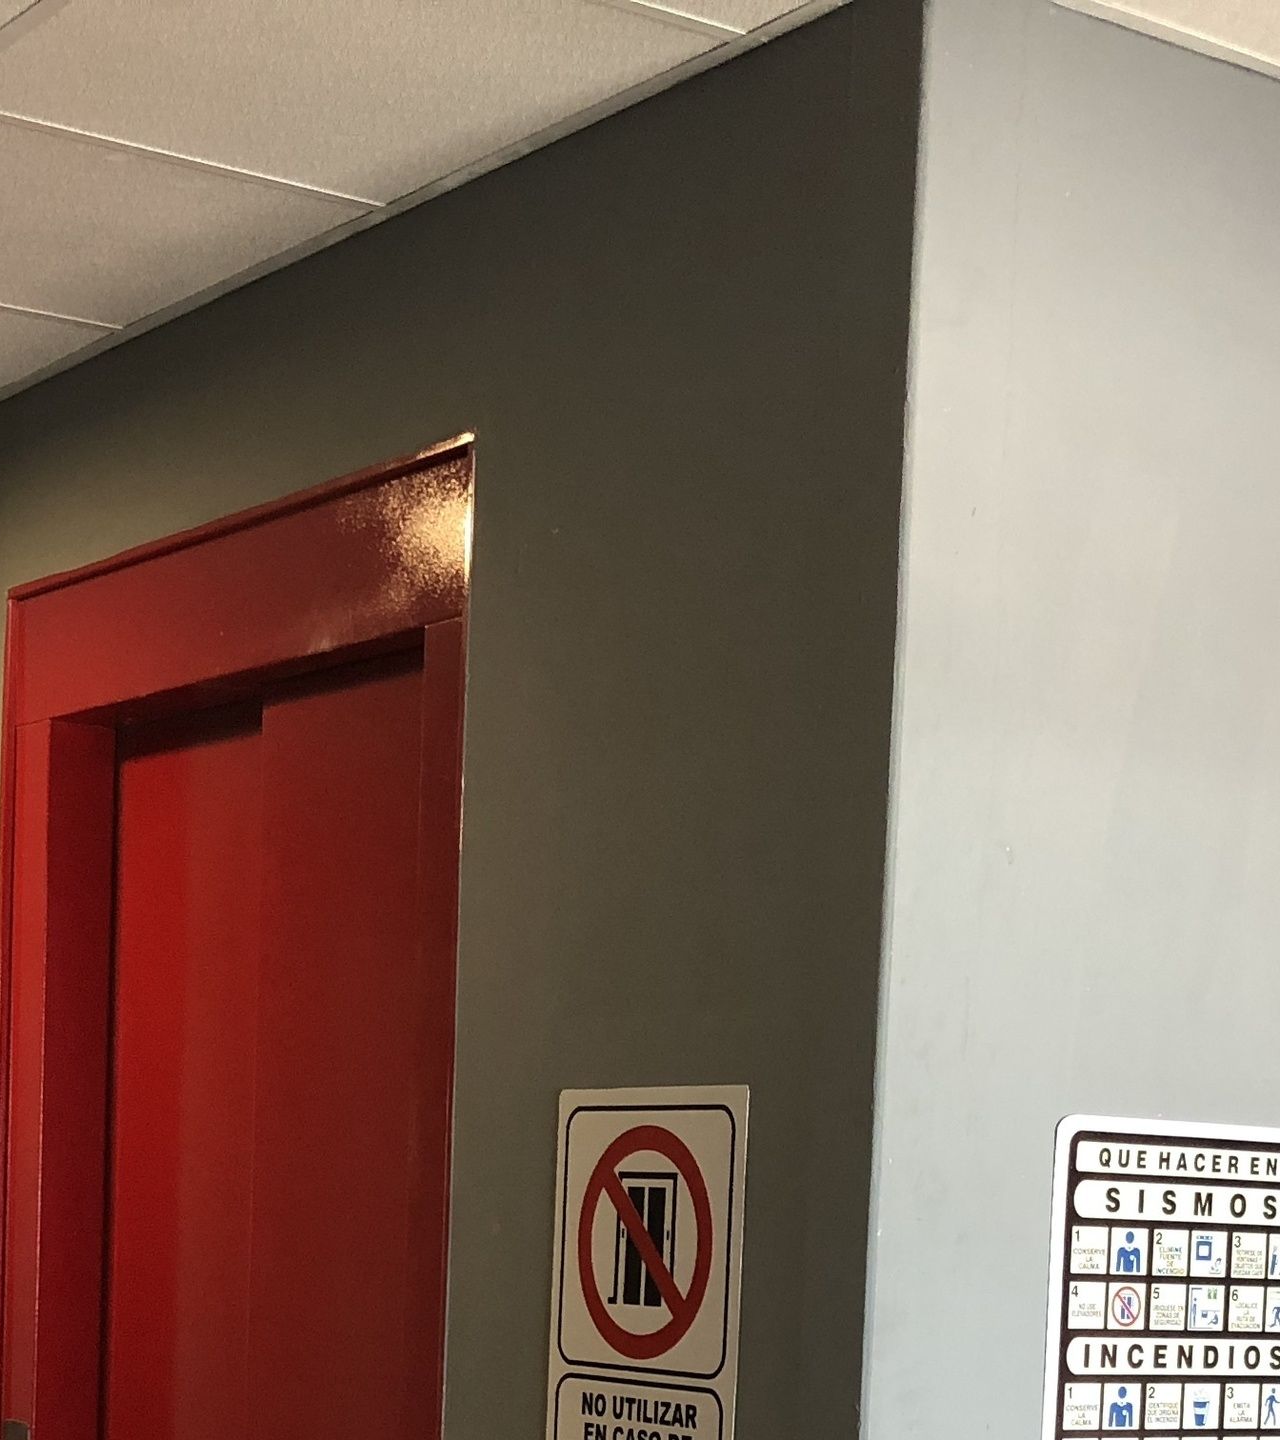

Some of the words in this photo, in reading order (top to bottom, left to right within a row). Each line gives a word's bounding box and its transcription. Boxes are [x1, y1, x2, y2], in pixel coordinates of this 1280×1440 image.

[1099, 1147, 1147, 1169] QUE
[1158, 1151, 1239, 1174] HACER
[1105, 1188, 1278, 1220] SISMOS
[1075, 1229, 1080, 1242] 1
[1155, 1232, 1163, 1245] 2
[1234, 1236, 1241, 1248] 3
[1071, 1285, 1079, 1297] 4
[1153, 1287, 1160, 1299] 5
[1231, 1289, 1238, 1301] 6
[1068, 1387, 1072, 1399] 1
[1148, 1387, 1155, 1399] 2
[1227, 1387, 1234, 1399] 3
[582, 1392, 607, 1417] NO
[612, 1395, 697, 1430] UTILIZAR
